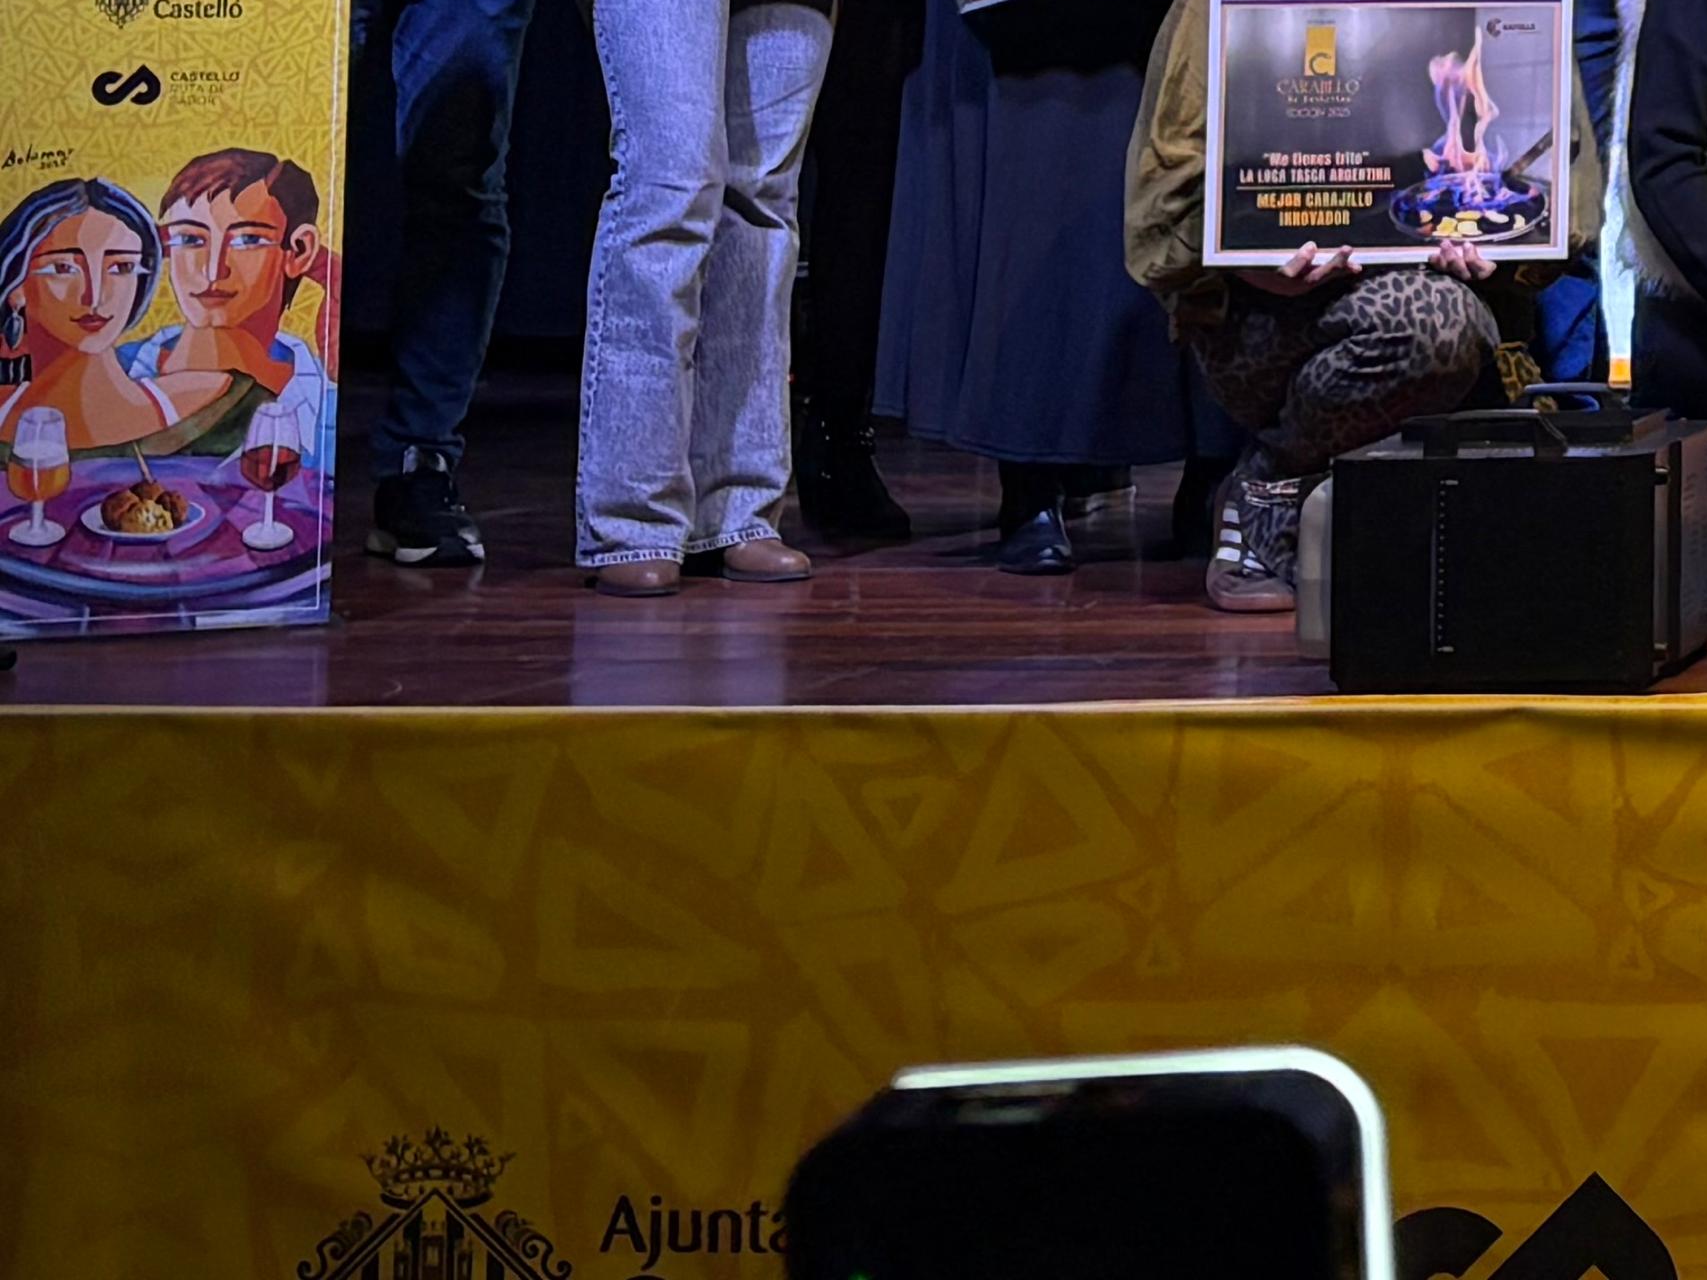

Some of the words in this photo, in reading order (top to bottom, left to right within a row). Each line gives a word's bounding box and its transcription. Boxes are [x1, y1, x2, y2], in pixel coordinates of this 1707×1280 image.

[1239, 169, 1254, 184] LA
[1257, 169, 1287, 183] LOCA
[1290, 168, 1327, 183] TASCA
[1329, 167, 1391, 182] ARGENTINA
[1257, 193, 1301, 209] MEJOR
[1305, 191, 1373, 207] CARAJILLO
[1279, 210, 1351, 227] INNOVADOR
[600, 1195, 790, 1260] Ajunta
